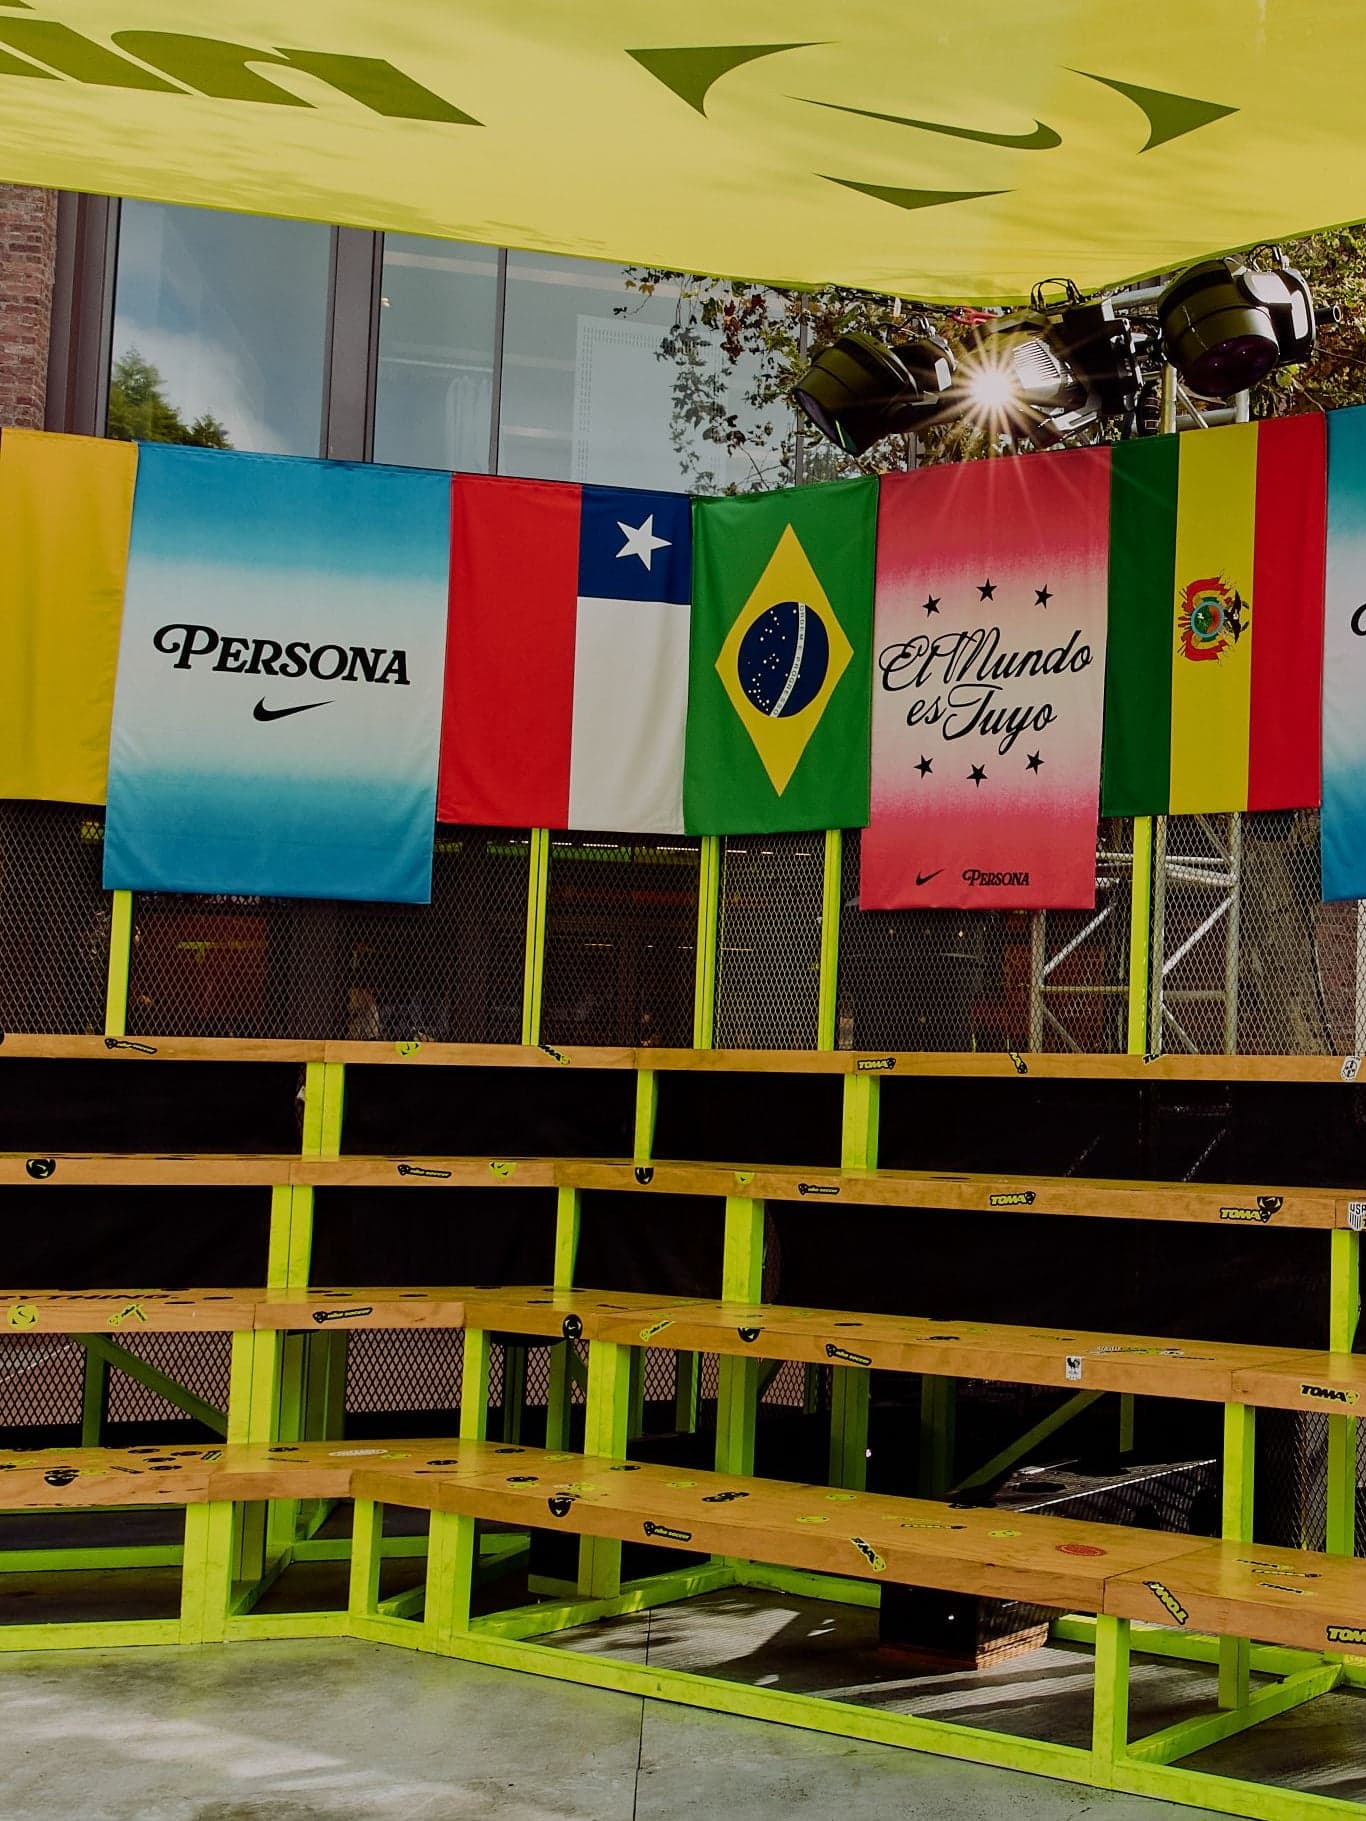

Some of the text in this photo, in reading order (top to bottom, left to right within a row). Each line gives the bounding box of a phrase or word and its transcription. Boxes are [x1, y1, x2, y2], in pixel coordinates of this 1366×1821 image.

[154, 624, 411, 686] PERSONA
[879, 627, 1093, 692] El Mundo
[907, 684, 1058, 756] es Tuyo
[962, 869, 1029, 887] PERSONA
[858, 1060, 890, 1070] TOMA
[990, 1195, 1027, 1206] TOMA
[1220, 1208, 1261, 1221] TOMA
[1301, 1384, 1347, 1402] TOMA
